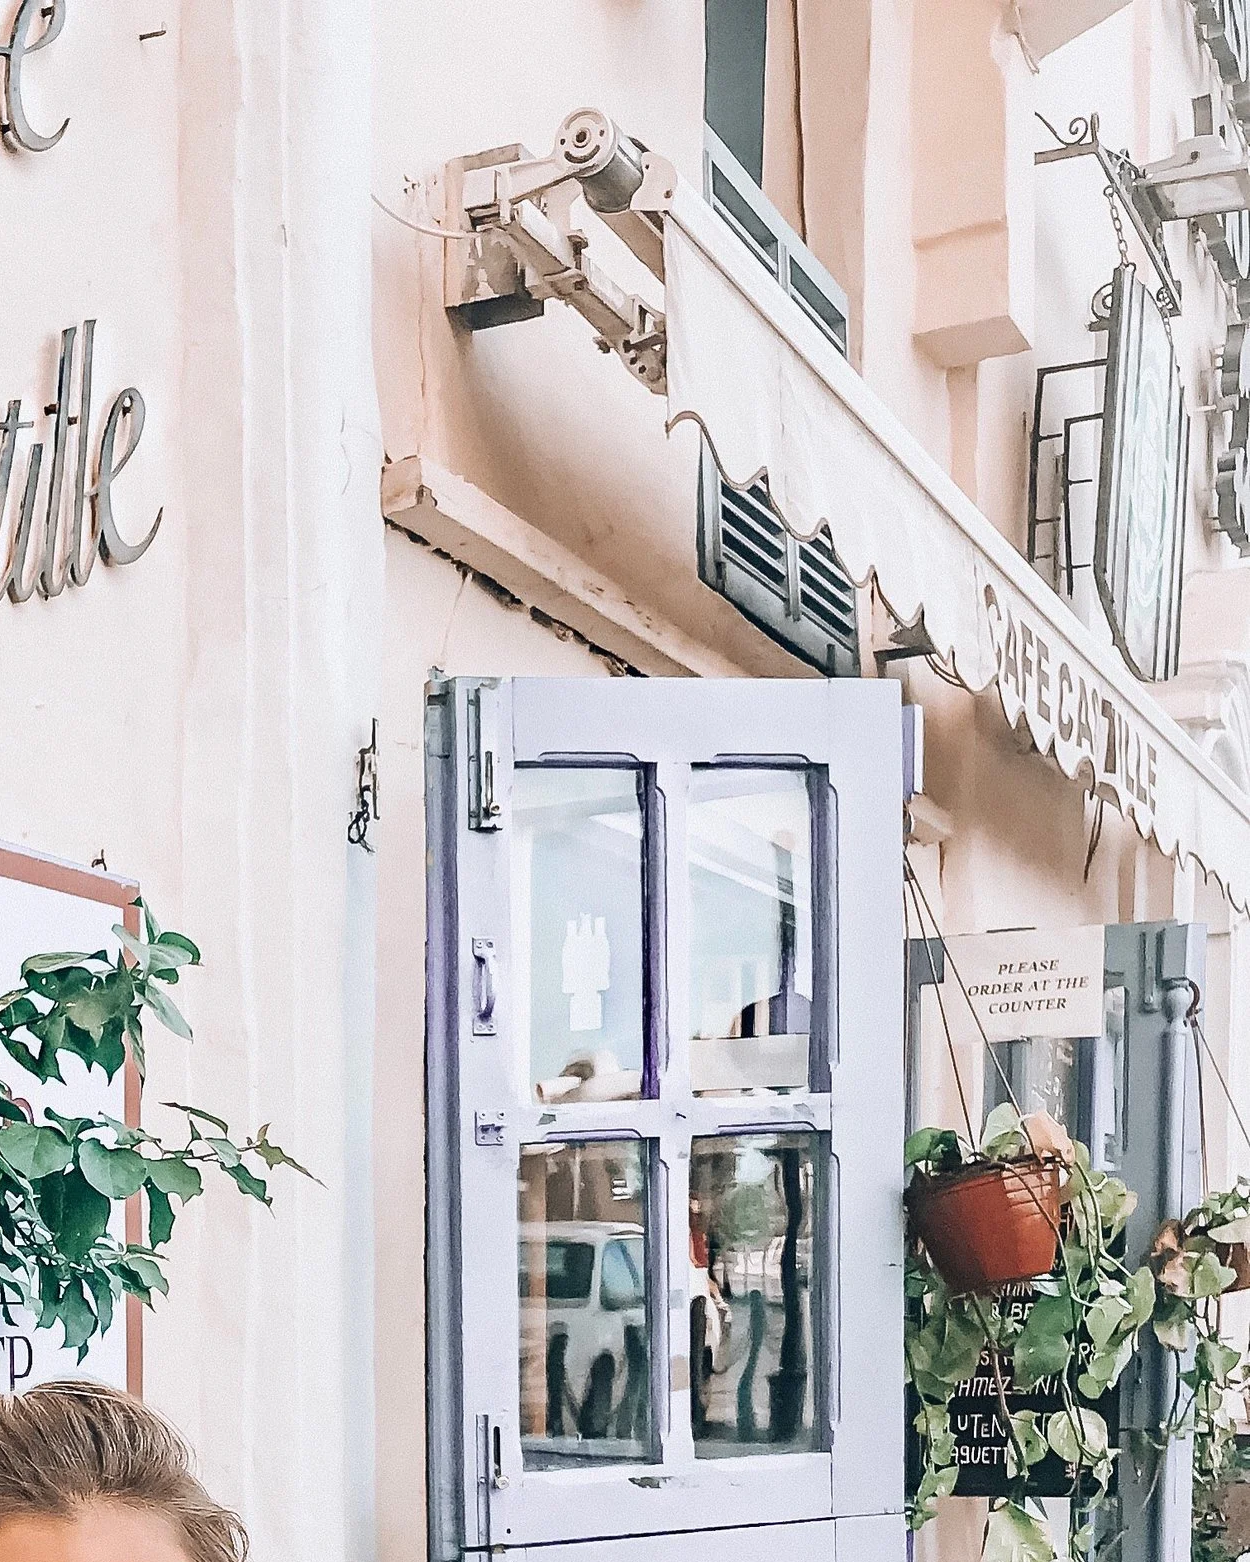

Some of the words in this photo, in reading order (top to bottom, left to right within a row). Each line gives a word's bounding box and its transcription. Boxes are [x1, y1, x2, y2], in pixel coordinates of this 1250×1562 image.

[998, 959, 1060, 976] PLEASE
[968, 981, 1024, 997] ORDER
[1028, 979, 1051, 992] AT
[1055, 976, 1090, 990] THE
[988, 997, 1068, 1015] COUNTER
